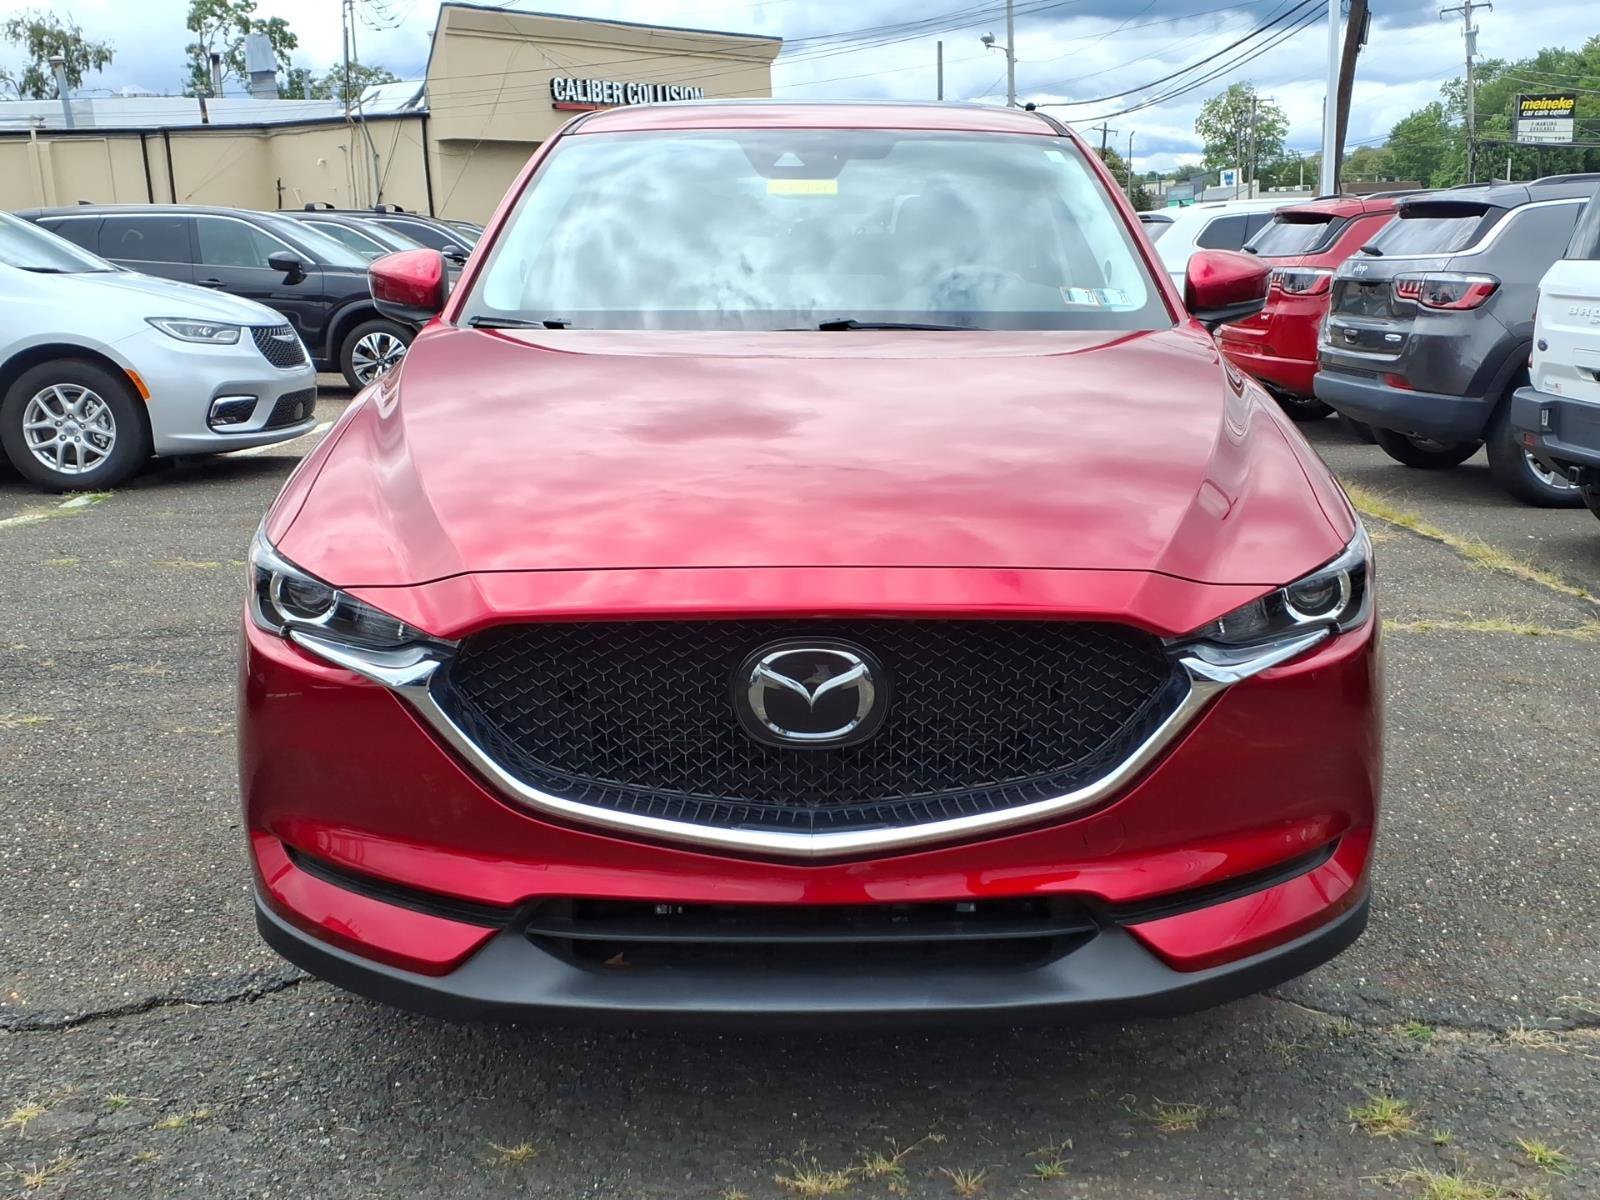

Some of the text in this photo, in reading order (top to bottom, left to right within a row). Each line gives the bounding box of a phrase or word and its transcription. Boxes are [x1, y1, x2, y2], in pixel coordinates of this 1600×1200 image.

[551, 76, 705, 104] CALIBER COLLISION
[1520, 97, 1574, 110] meineke
